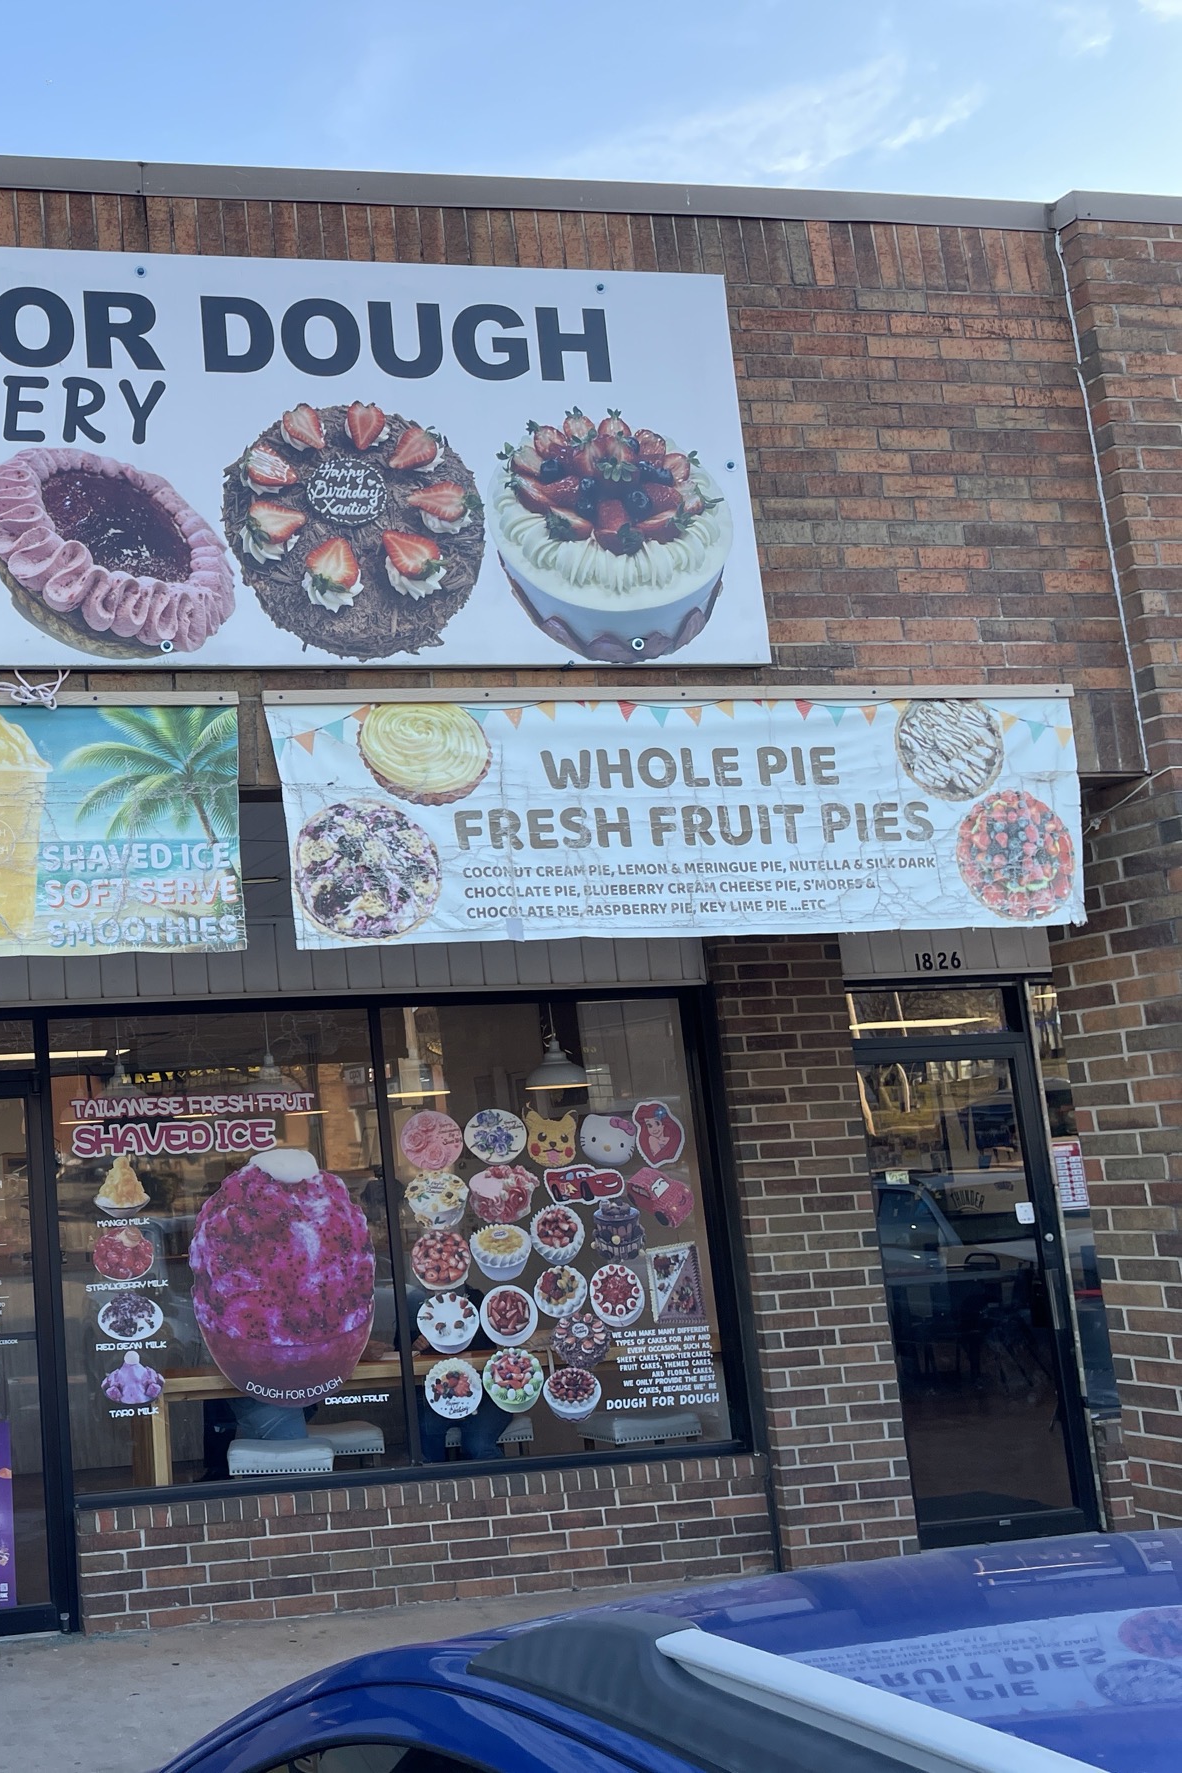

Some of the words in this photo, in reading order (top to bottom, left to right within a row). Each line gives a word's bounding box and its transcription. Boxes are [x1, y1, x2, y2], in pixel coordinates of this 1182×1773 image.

[200, 295, 613, 383] DOUGH
[319, 463, 370, 484] Happy
[311, 479, 383, 506] Birthday
[540, 747, 743, 790] WHOLE
[756, 746, 840, 786] PIE
[454, 806, 632, 851] FRESH
[649, 804, 804, 848] FRUIT
[821, 801, 935, 844] PIES
[42, 842, 172, 872] SHAVED
[181, 842, 231, 869] ICE
[463, 865, 532, 879] COCONUT
[535, 864, 585, 878] CREAM
[588, 864, 615, 878] PIE,
[618, 863, 667, 876] LEMON
[671, 862, 680, 875] &
[684, 861, 757, 874] MERINGUE
[760, 860, 786, 874] PIE,
[789, 858, 850, 872] NUTELLA
[854, 858, 864, 871] &
[866, 857, 896, 870] SILK
[898, 856, 936, 869] DARK
[45, 876, 127, 909] SOFT
[136, 874, 240, 905] SERVE
[464, 885, 551, 899] CHOCOLATE
[554, 884, 581, 898] PIE,
[584, 883, 664, 897] BLUEBERRY
[667, 881, 716, 894] CREAM
[719, 880, 774, 893] CHEESE
[776, 880, 801, 893] PIE,
[803, 878, 863, 891] S'MORES
[866, 877, 876, 889] &
[466, 905, 554, 919] CHOCOLATE
[558, 904, 584, 918] PIE,
[586, 903, 667, 917] RASPBERRY
[671, 902, 696, 916] PIE,
[700, 901, 727, 914] KEY
[730, 900, 763, 913] LIME
[766, 899, 788, 912] PIE
[46, 914, 239, 948] SMOOTHIES
[915, 951, 961, 971] 1826
[71, 1096, 184, 1118] TAIWANESE
[187, 1094, 256, 1115] FRESH
[257, 1092, 315, 1113] FRUIT
[73, 1122, 212, 1157] SHAVED
[217, 1120, 276, 1151] ICE
[97, 1219, 127, 1227] MANGO
[129, 1217, 150, 1226] MILK
[147, 1279, 169, 1288] MILK
[612, 1331, 622, 1339] WE
[624, 1330, 636, 1338] CAN
[639, 1329, 656, 1337] MAKE
[677, 1325, 710, 1334] DIFFERENT
[615, 1339, 635, 1347] TYPES
[698, 1333, 710, 1341] AND
[95, 1343, 115, 1351] RED
[117, 1341, 142, 1350] BEAN
[145, 1341, 167, 1349] MILK
[619, 1364, 638, 1372] FRUIT
[664, 1360, 689, 1368] THEMED
[652, 1370, 664, 1378] AND
[245, 1381, 284, 1399] DOUGH
[286, 1389, 306, 1400] FOR
[307, 1376, 343, 1398] DOUGH
[663, 1384, 691, 1392] BECAUSE
[325, 1395, 361, 1405] DRAGON
[362, 1393, 390, 1403] FRUIT
[606, 1398, 647, 1410] DOUGH
[652, 1395, 675, 1407] FOR
[680, 1393, 720, 1405] DOUGH
[109, 1408, 135, 1418] TARO
[137, 1406, 159, 1416] MILK
